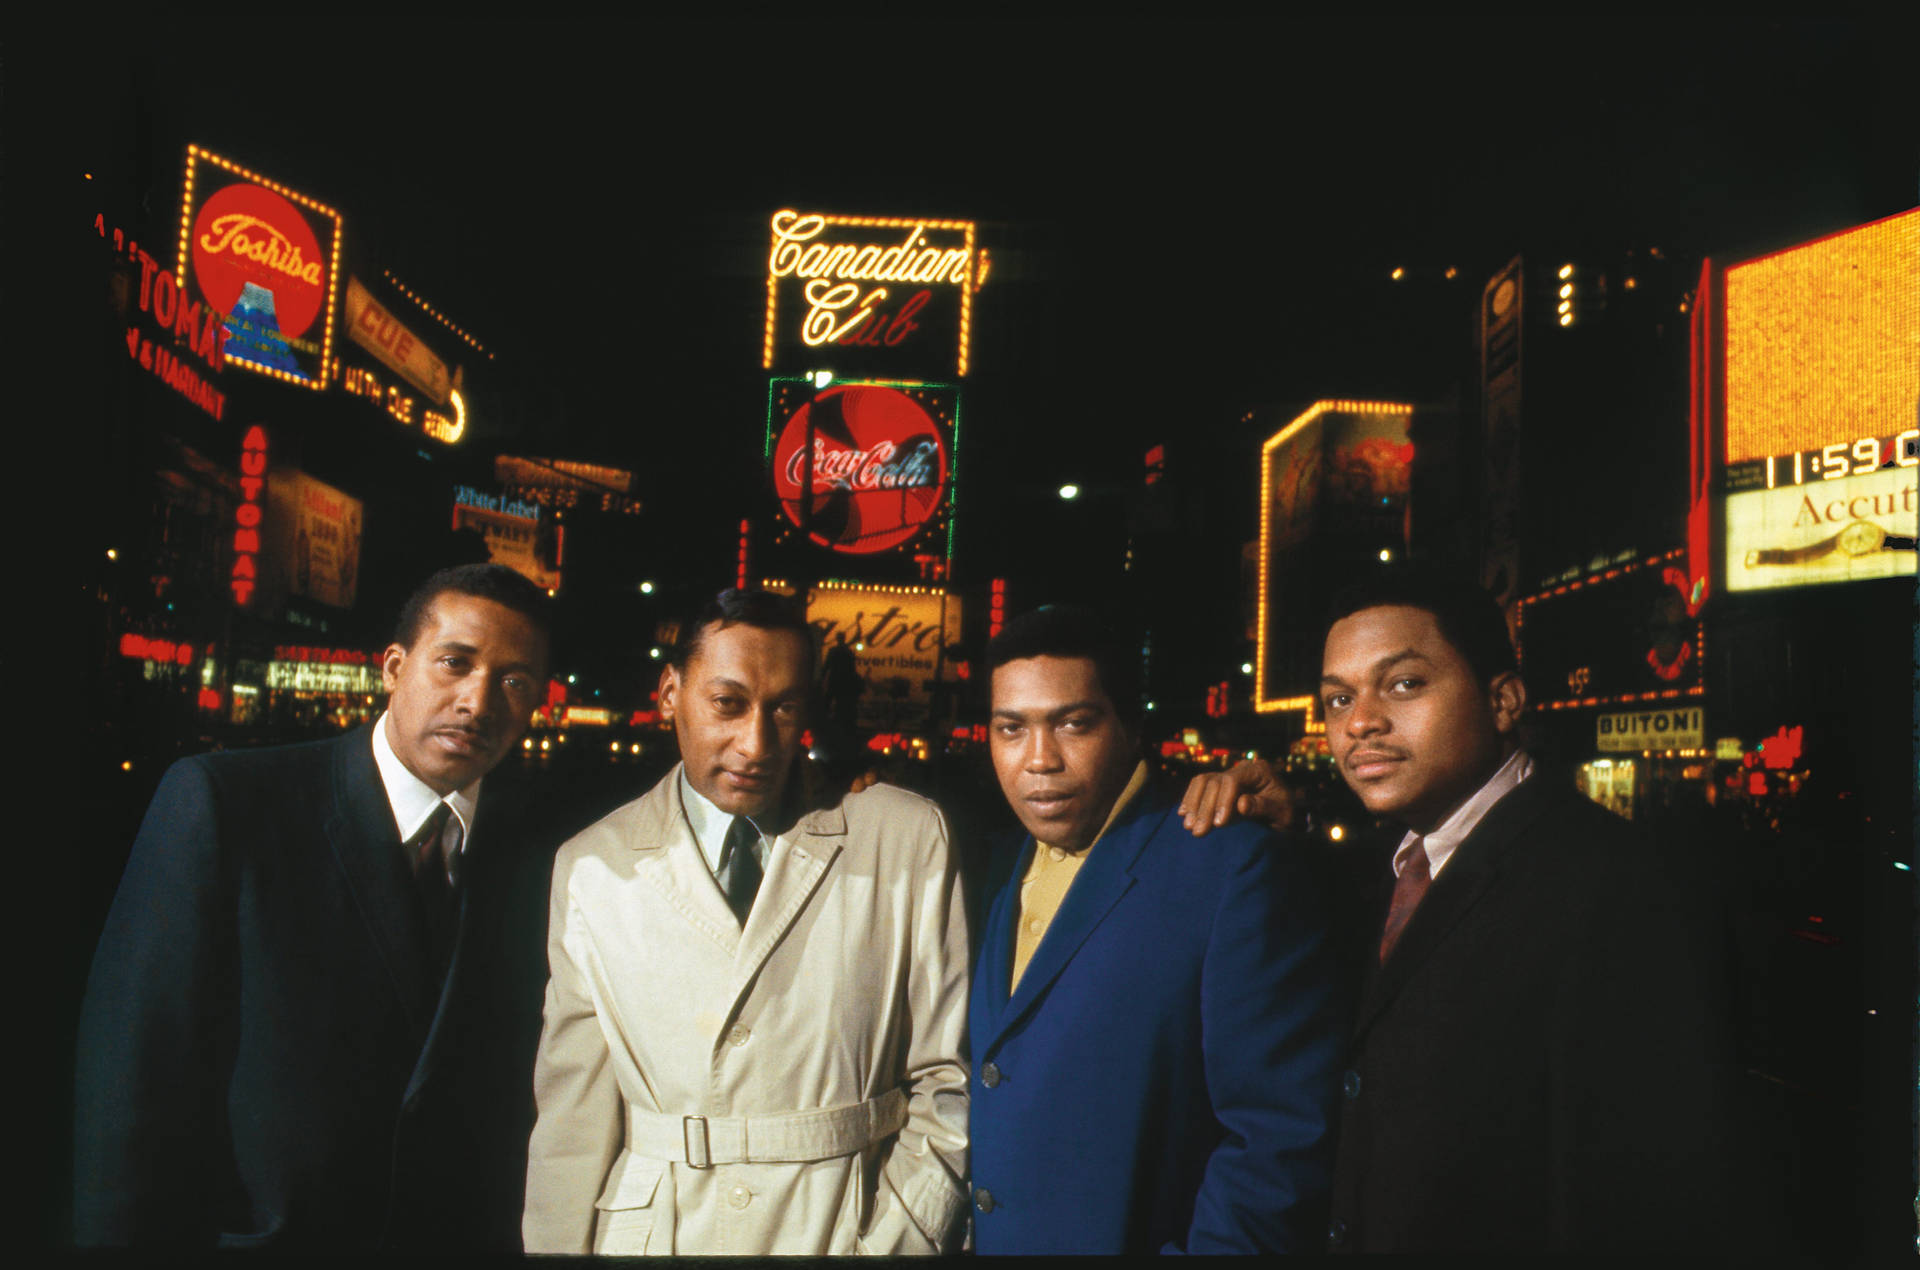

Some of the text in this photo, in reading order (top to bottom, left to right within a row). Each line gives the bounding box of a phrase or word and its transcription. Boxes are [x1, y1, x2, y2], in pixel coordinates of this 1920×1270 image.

[201, 214, 321, 285] Toshiba
[770, 210, 967, 283] Canadian
[802, 278, 932, 345] Club
[1766, 437, 1881, 490] 11:59
[231, 426, 267, 605] AUTOMAT
[1792, 484, 1918, 529] Accut
[1600, 711, 1699, 735] BUITONI
